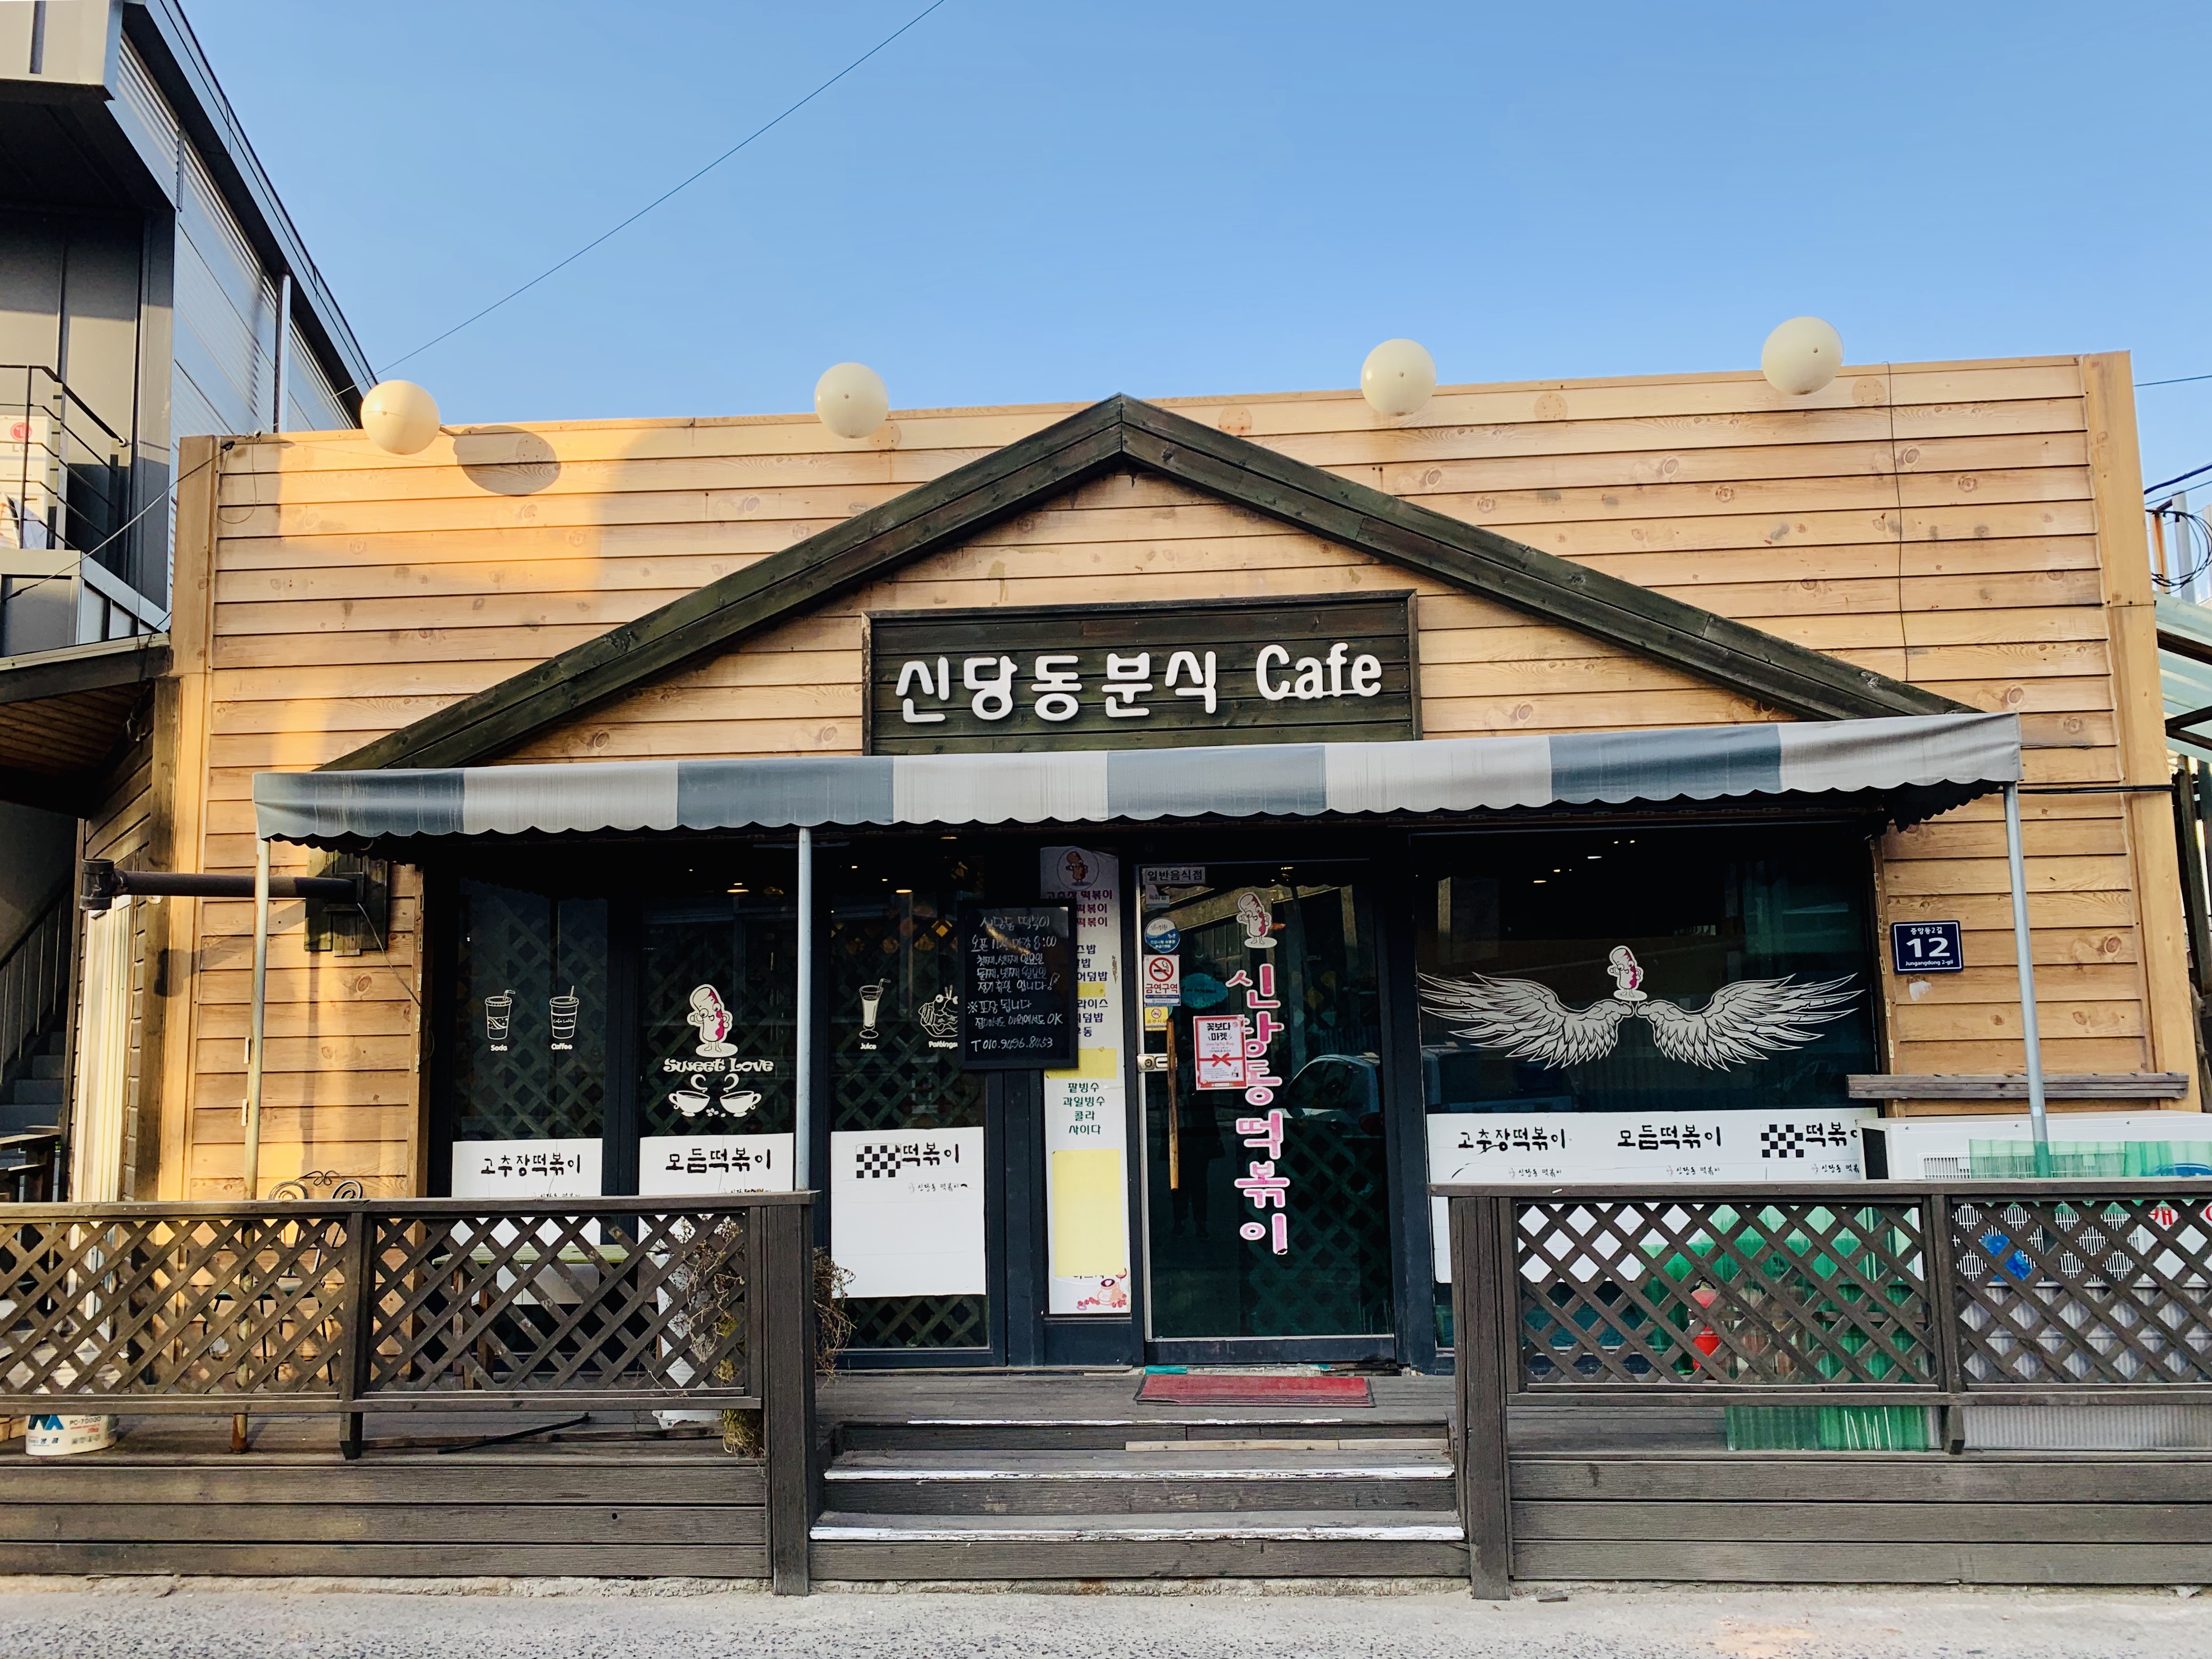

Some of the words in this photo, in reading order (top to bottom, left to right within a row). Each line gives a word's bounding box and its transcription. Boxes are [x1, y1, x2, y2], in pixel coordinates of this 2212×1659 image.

[895, 650, 1216, 724] 신당동분식
[1254, 642, 1383, 701] Cafe
[1147, 869, 1202, 881] 일반음식점
[1081, 889, 1113, 901] 떡볶이
[971, 934, 988, 952] 오픈
[1906, 937, 1950, 958] 12
[1145, 983, 1178, 994] 금연구역
[1000, 998, 1032, 1013] 됩니다
[1047, 1013, 1063, 1026] OK
[1207, 1022, 1231, 1031] 꽃보다
[1211, 1032, 1228, 1041] 마켓
[970, 1040, 982, 1052] T
[662, 1058, 726, 1073] Sweet
[729, 1057, 774, 1073] Love
[1068, 1082, 1099, 1093] 팥빙수
[1063, 1096, 1105, 1107] 과일빙수
[1075, 1110, 1095, 1121] 콜라
[1068, 1124, 1102, 1135] 사이다
[902, 1142, 960, 1167] 떡볶이
[1518, 1168, 1538, 1177] 신당동
[1676, 1166, 1696, 1176] 신당동
[1822, 1164, 1841, 1173] 신당동
[917, 1183, 936, 1192] 신당동
